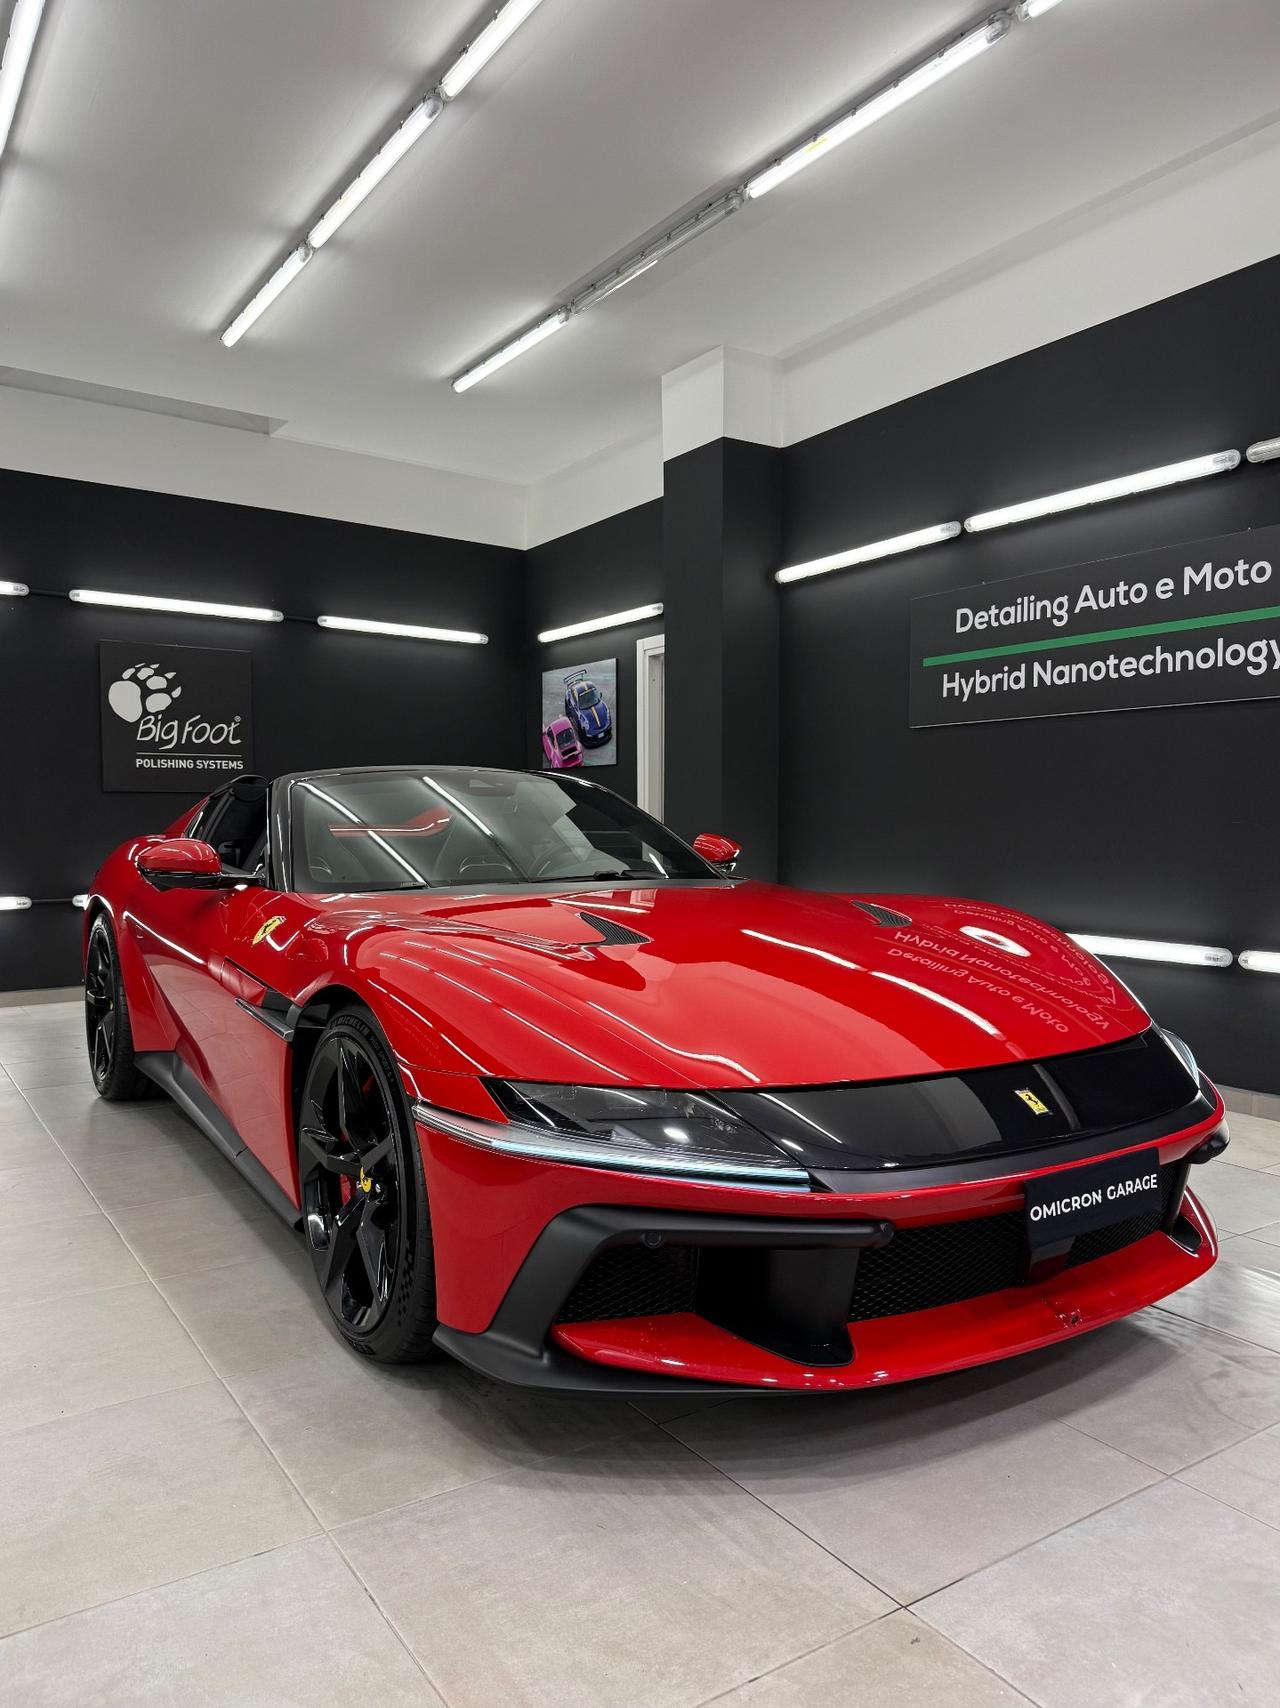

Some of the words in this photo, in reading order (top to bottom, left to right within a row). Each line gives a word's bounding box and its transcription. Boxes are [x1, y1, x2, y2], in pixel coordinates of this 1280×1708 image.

[955, 594, 1069, 634] Detailing
[1073, 580, 1148, 614] Auto
[1155, 577, 1175, 600] e
[1183, 559, 1272, 596] Moto
[942, 663, 1026, 703] Hybrid
[136, 758, 194, 768] POLISHING
[196, 760, 244, 770] SYSTEMS
[1029, 1188, 1103, 1222] OMICRON
[1106, 1174, 1158, 1200] GARAGE
